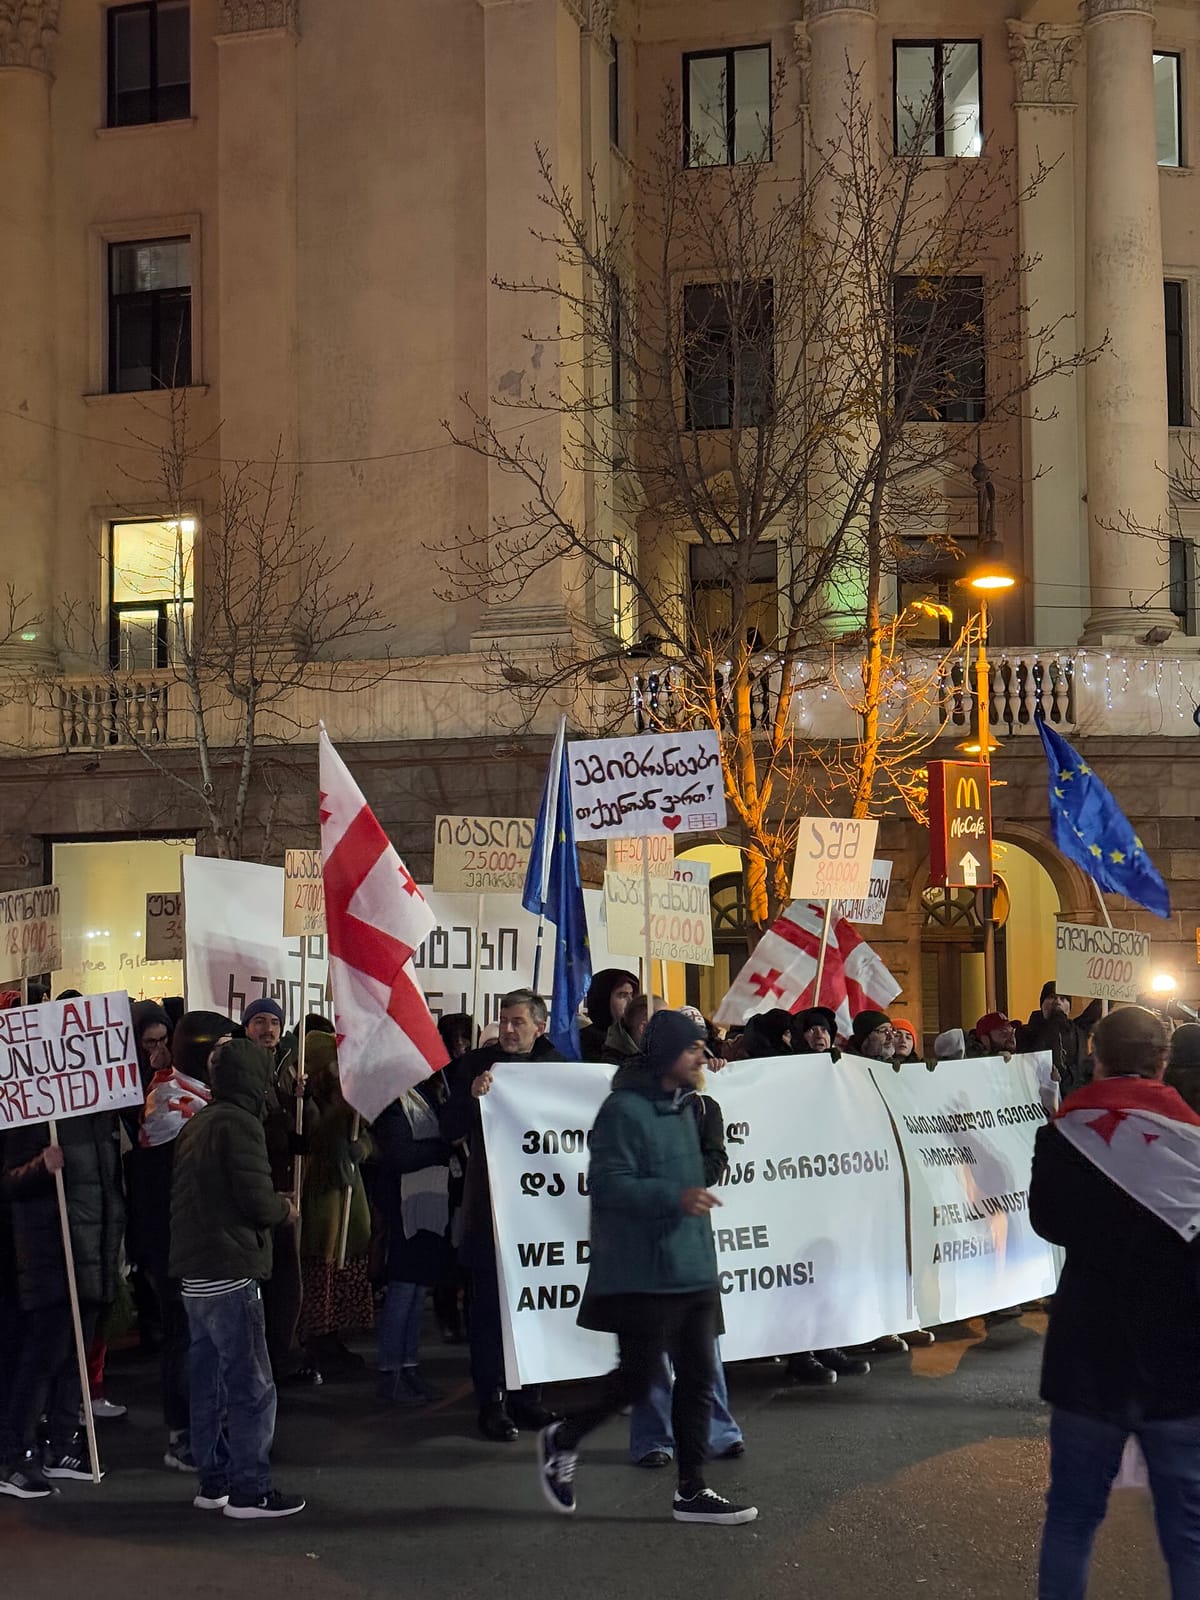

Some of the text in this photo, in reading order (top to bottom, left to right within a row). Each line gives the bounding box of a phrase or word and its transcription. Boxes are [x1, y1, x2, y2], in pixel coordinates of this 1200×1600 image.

[809, 822, 861, 859] აშშ
[61, 997, 124, 1037] ALL
[763, 1149, 889, 1182] არჩევნებს!
[520, 1172, 566, 1197] და
[933, 1204, 963, 1227] FREE
[963, 1198, 986, 1222] ALL
[713, 1225, 770, 1253] REE
[932, 1236, 996, 1265] ARRESTE
[517, 1241, 565, 1268] WE
[516, 1284, 581, 1312] AND
